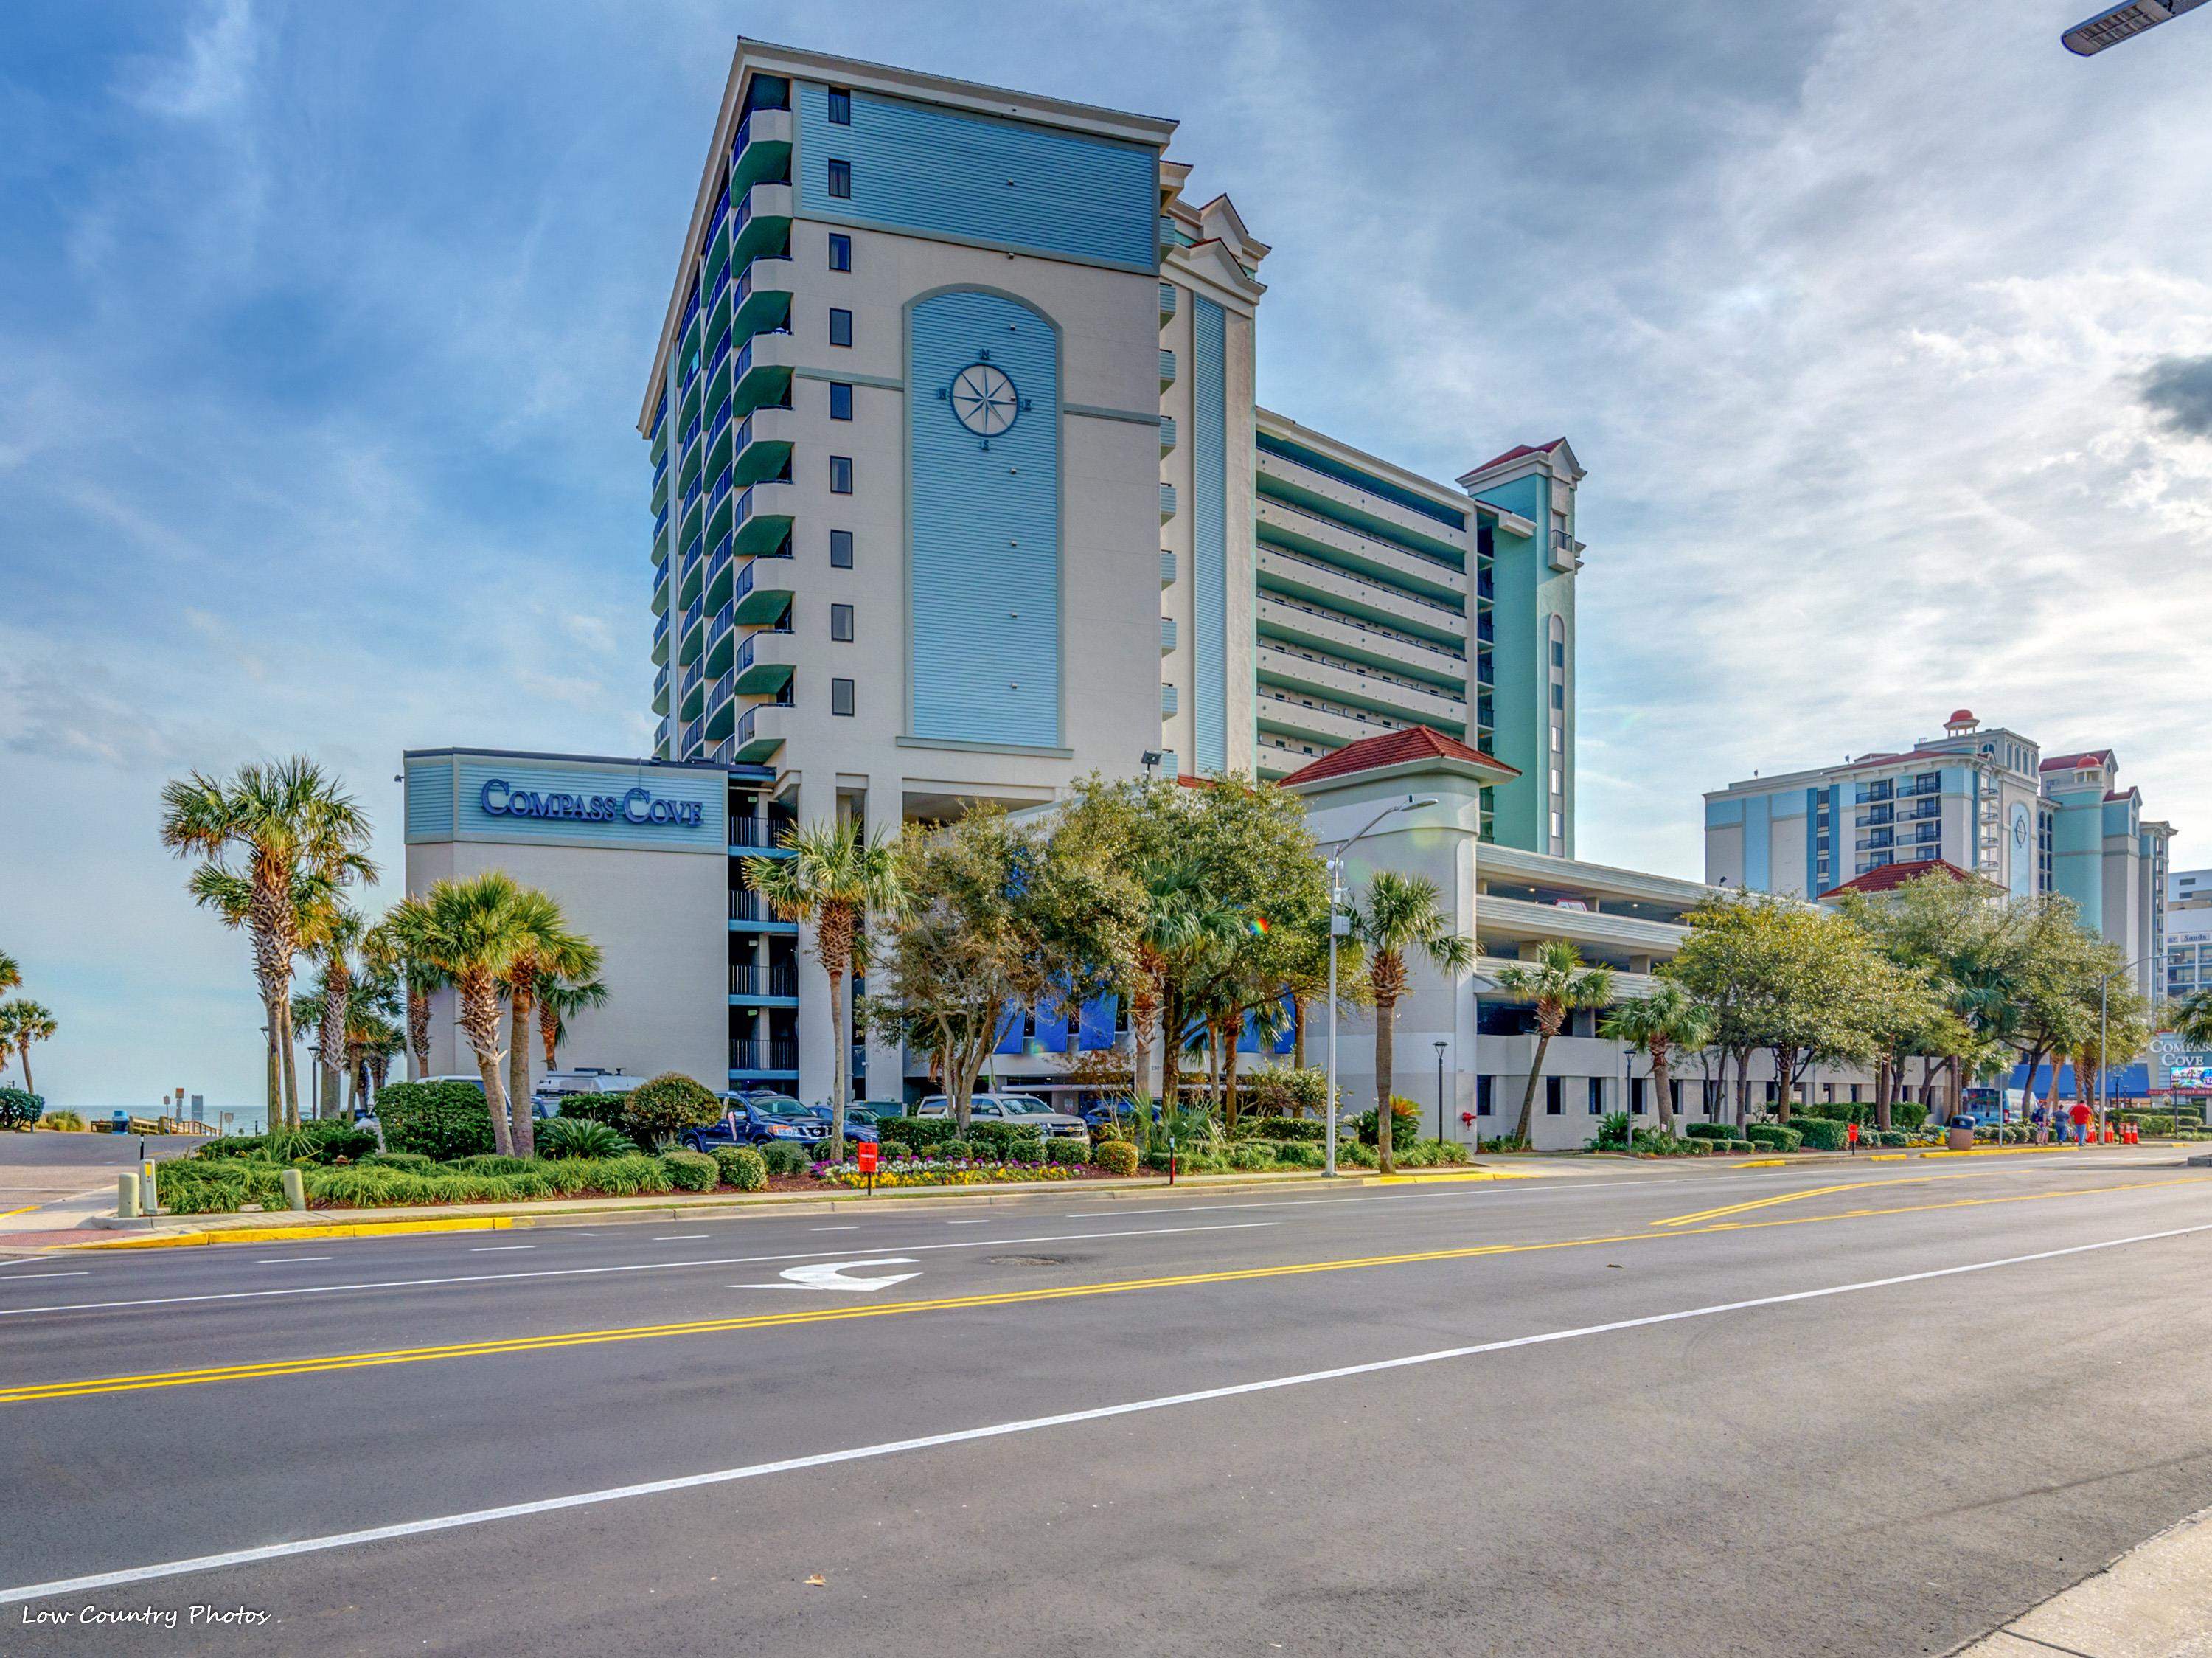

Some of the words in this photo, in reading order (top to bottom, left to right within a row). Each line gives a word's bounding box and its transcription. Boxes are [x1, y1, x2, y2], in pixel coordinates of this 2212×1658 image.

[979, 348, 990, 361] N
[1023, 399, 1032, 412] E
[980, 439, 990, 451] S
[481, 778, 617, 822] COMPASS
[623, 787, 703, 827] COVE
[2161, 1052, 2204, 1066] COVE
